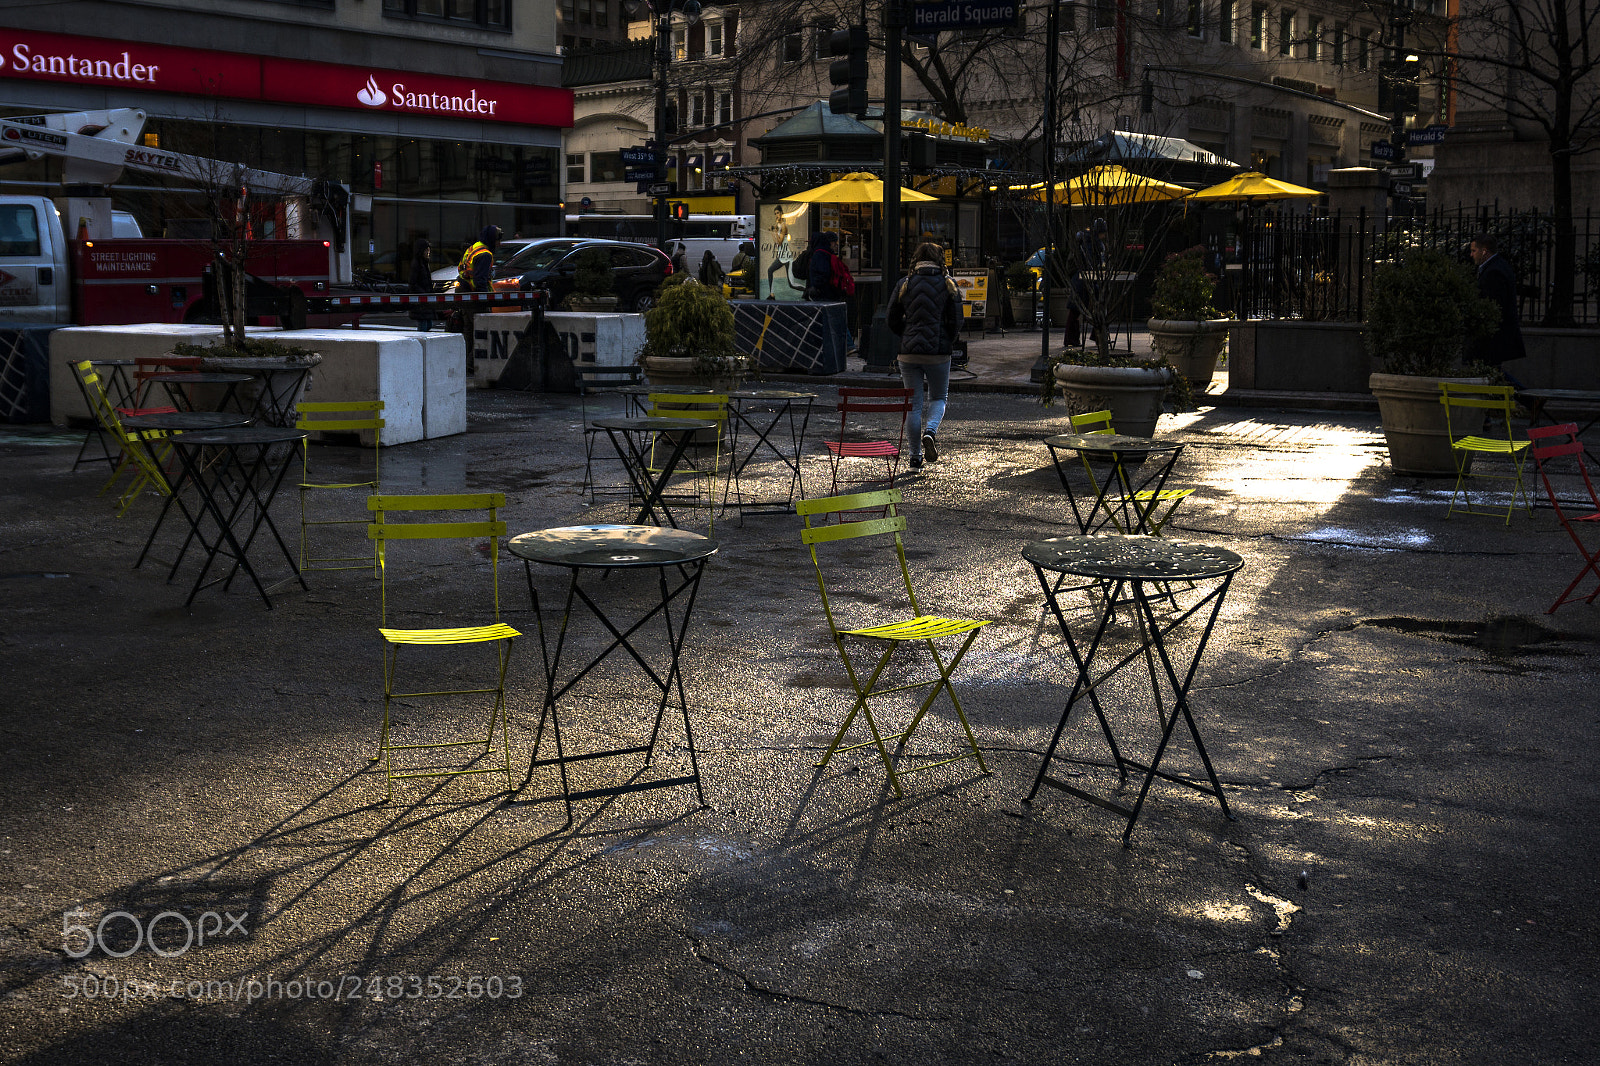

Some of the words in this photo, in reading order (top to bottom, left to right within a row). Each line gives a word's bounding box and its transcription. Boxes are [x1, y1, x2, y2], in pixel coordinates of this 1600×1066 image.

[915, 5, 960, 24] Herald
[965, 5, 1013, 24] Square
[12, 43, 160, 82] Santander
[391, 83, 497, 115] Santander
[1409, 131, 1436, 141] Herald
[124, 149, 181, 169] SKYTEL
[91, 252, 119, 262] STREET
[121, 252, 156, 262] LIGHTING
[96, 262, 151, 272] MAINTENANCE
